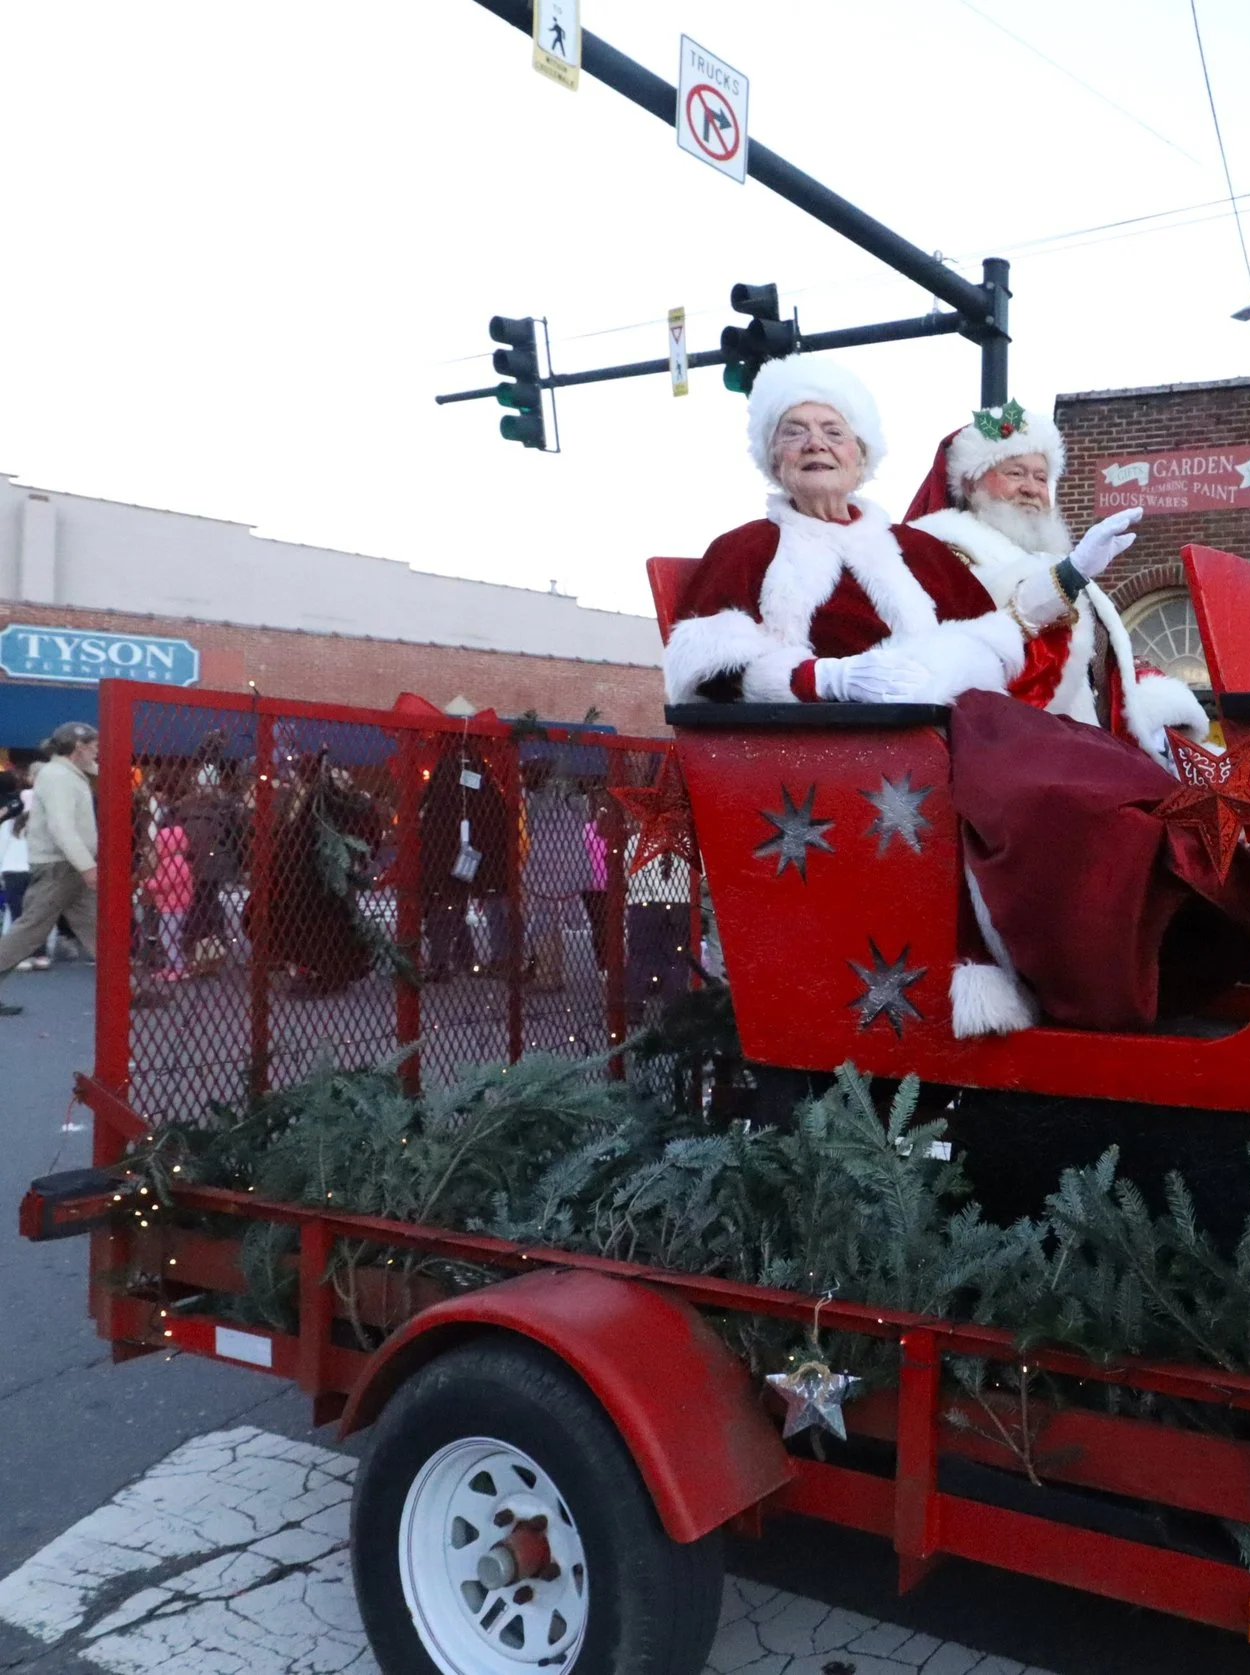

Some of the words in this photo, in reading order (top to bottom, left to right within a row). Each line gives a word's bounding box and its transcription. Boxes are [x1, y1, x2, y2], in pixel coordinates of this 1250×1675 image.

[691, 49, 740, 96] TRUCKS
[1152, 455, 1234, 478] GARDEN
[1141, 480, 1189, 493] PLUMBING
[1193, 482, 1239, 503] PAINT
[1099, 492, 1189, 508] HOUSEWARES
[17, 633, 176, 669] TYSON
